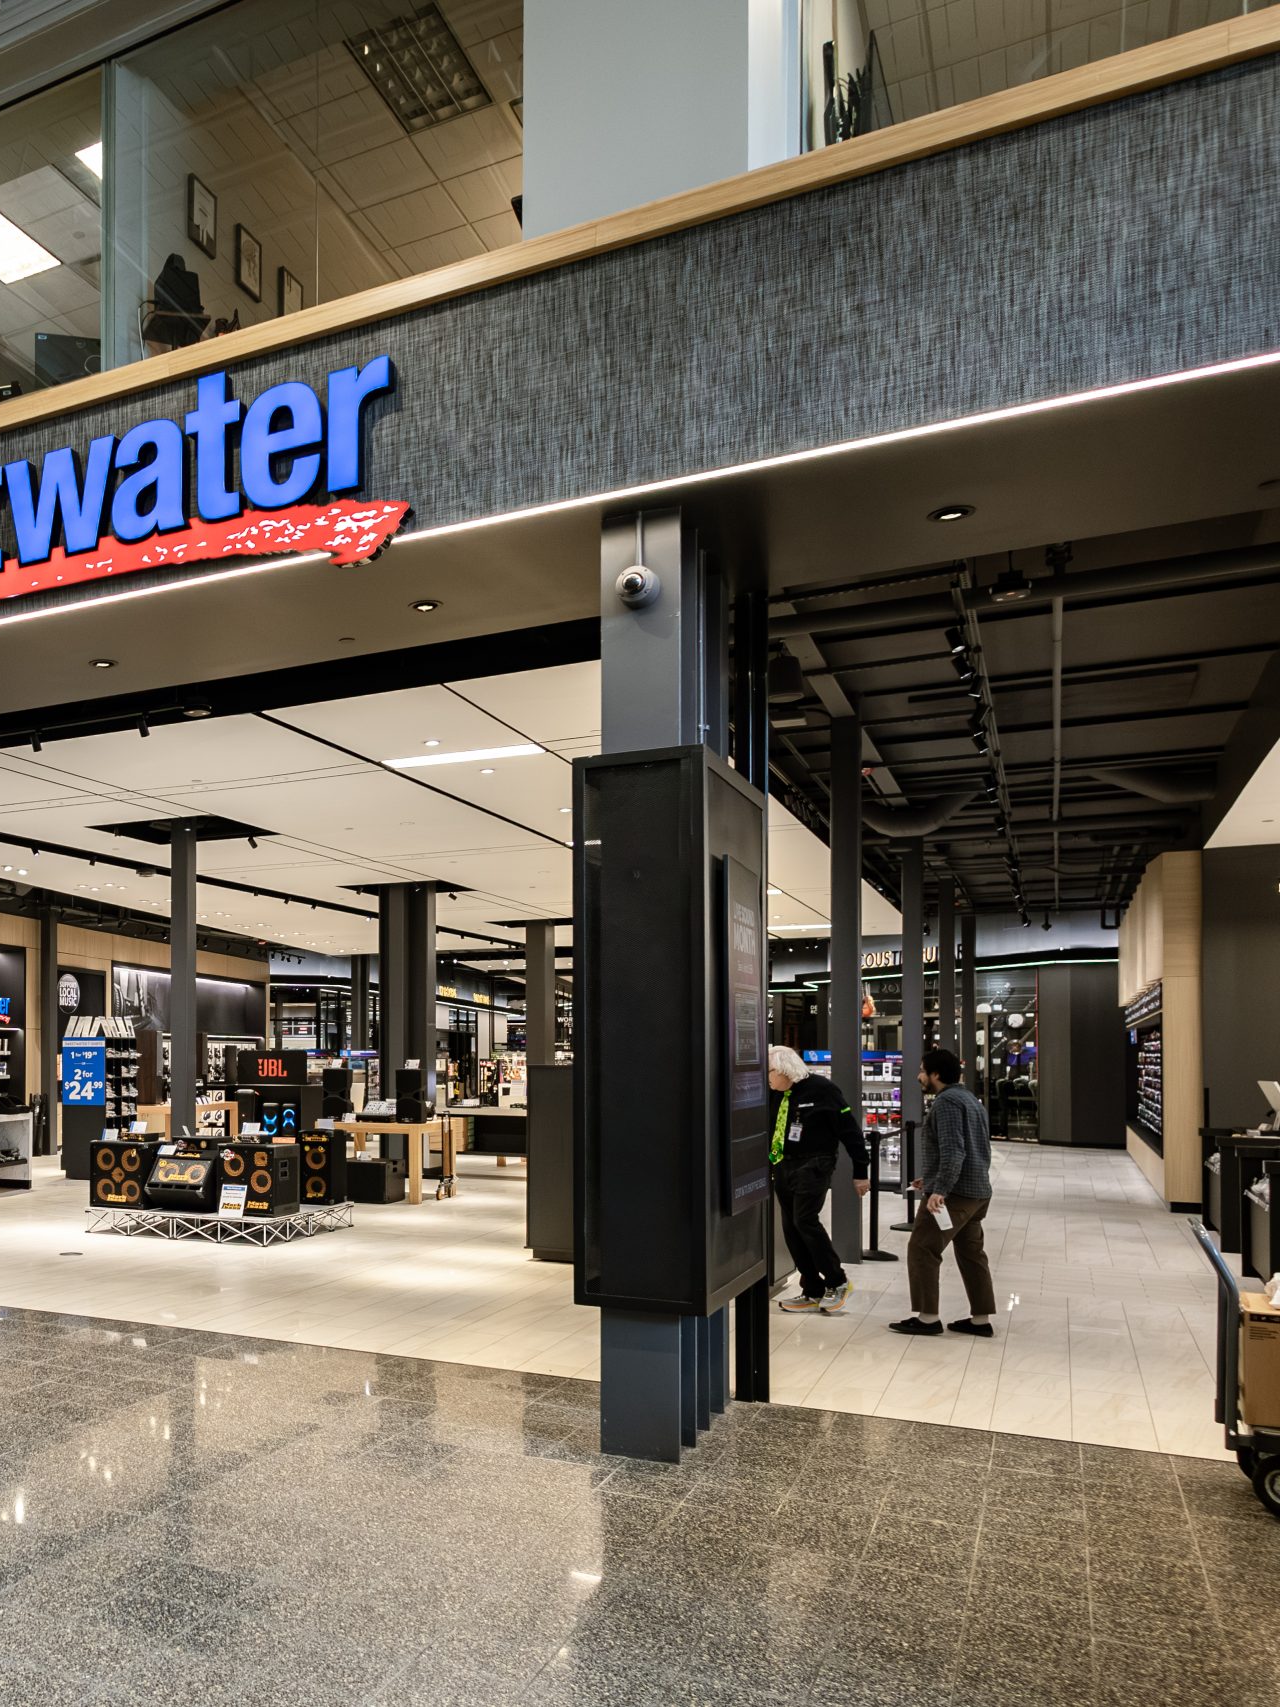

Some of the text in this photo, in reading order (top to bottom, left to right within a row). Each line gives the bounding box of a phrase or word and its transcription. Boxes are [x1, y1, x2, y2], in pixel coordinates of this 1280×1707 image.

[59, 987, 77, 997] LOCAL
[59, 997, 77, 1006] MUSIC
[70, 1051, 75, 1059] 1
[257, 1059, 288, 1077] JBL
[74, 1069, 93, 1080] 2 for
[64, 1081, 103, 1100] $24.99
